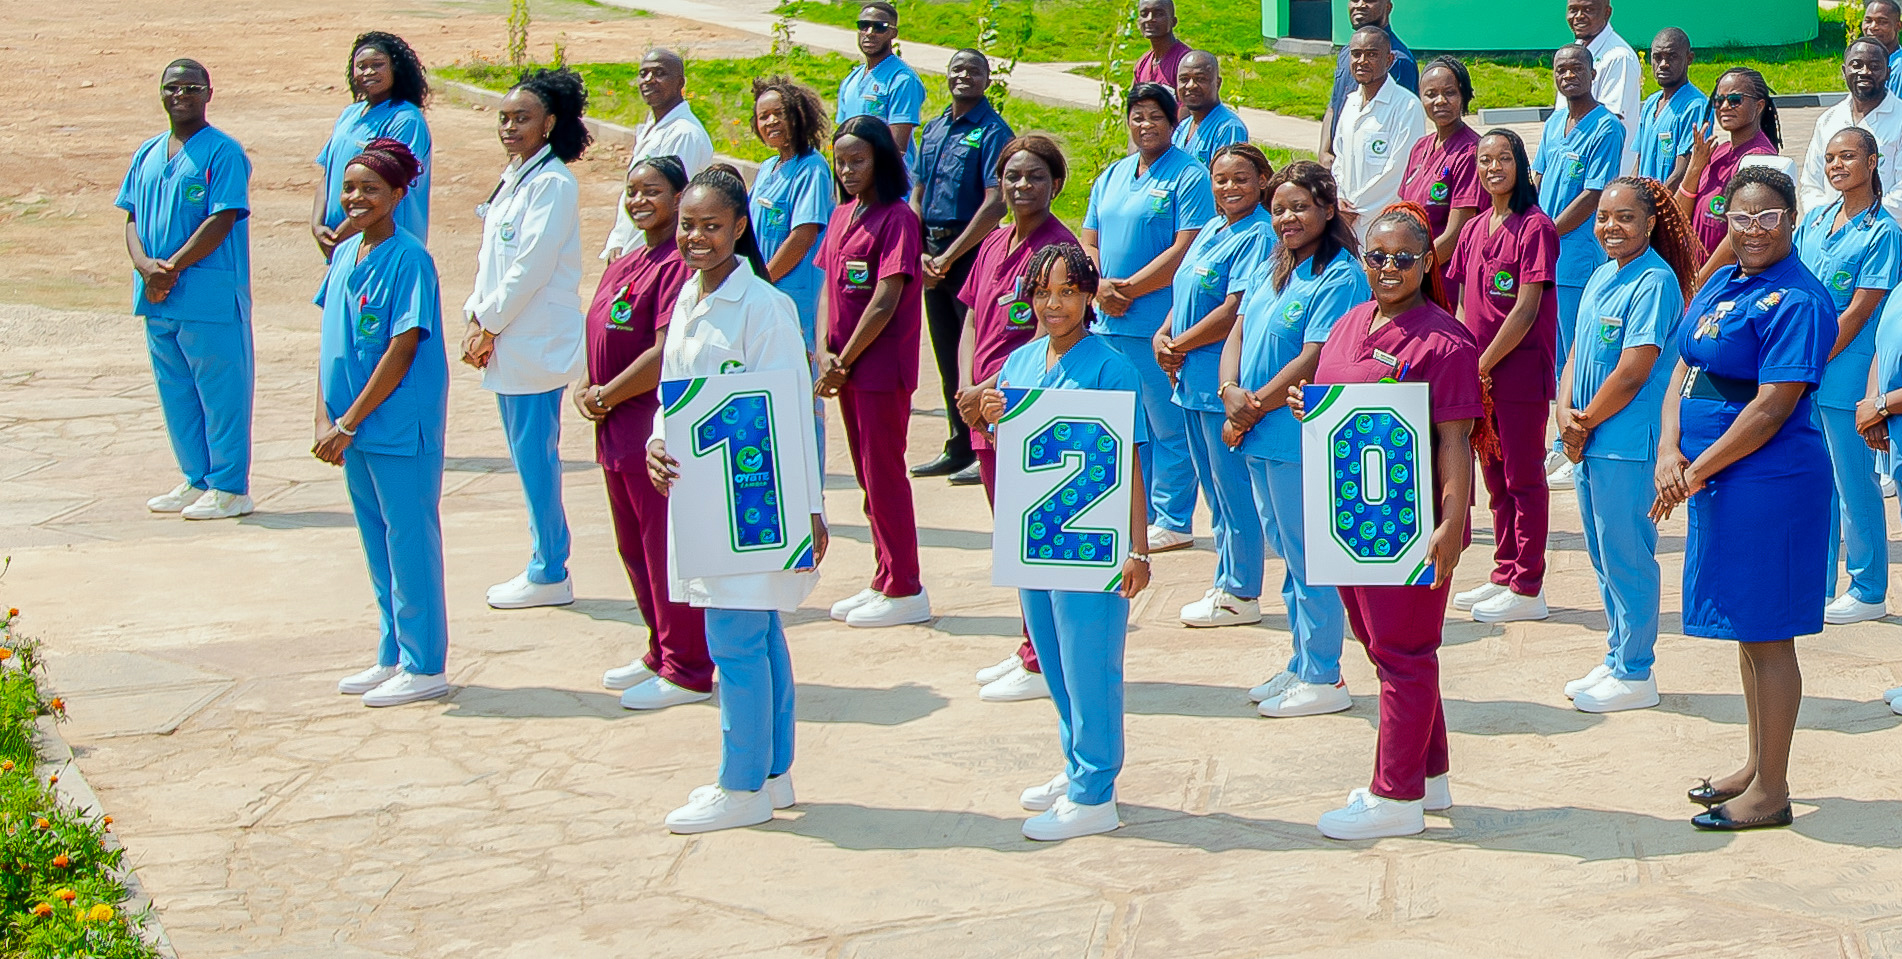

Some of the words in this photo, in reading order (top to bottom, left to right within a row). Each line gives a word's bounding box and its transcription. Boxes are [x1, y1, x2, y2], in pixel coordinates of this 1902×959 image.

[691, 390, 787, 553] 1
[1020, 416, 1122, 567] 2
[1328, 407, 1422, 564] 0
